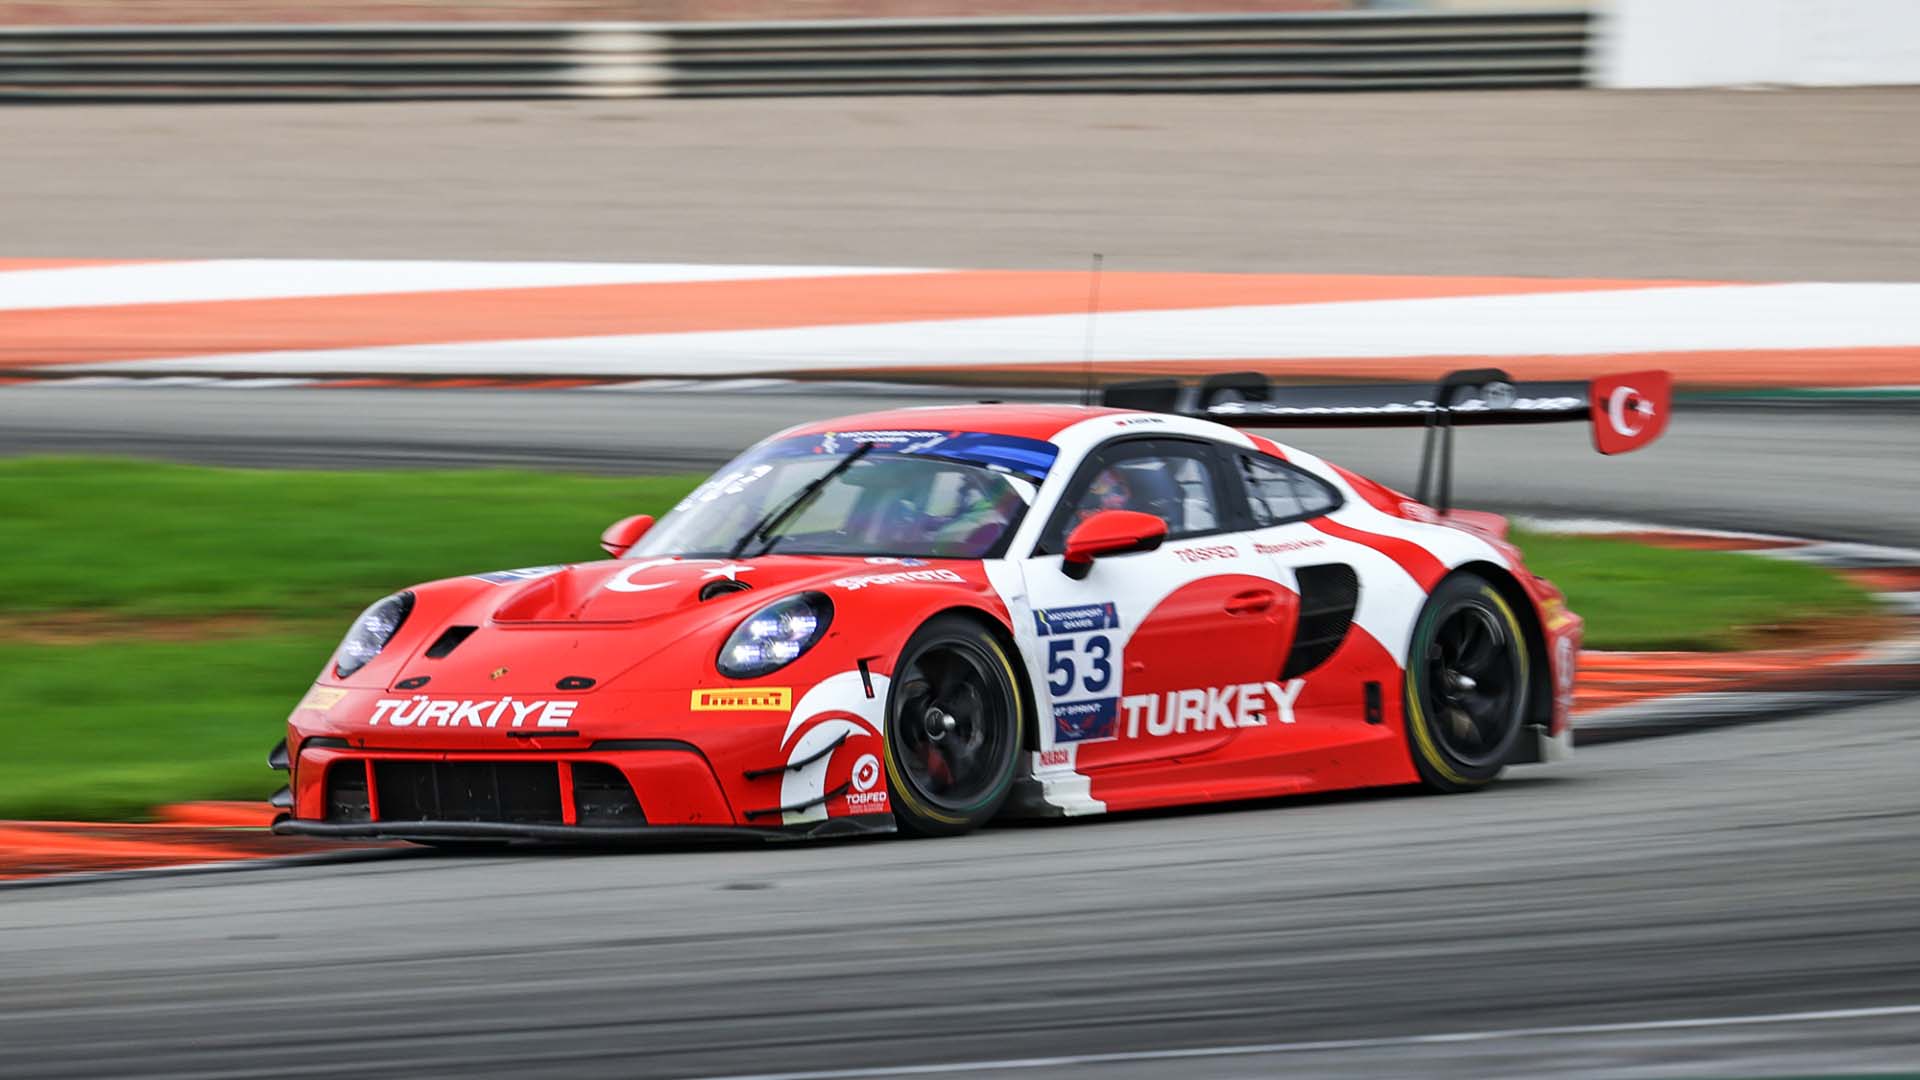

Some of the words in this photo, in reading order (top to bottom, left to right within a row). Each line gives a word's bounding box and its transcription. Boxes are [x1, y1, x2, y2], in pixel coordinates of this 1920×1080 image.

[1047, 635, 1111, 697] 53
[369, 695, 579, 728] TÜRKİYE
[700, 692, 782, 706] PIRELLI
[1121, 678, 1307, 739] TURKEY
